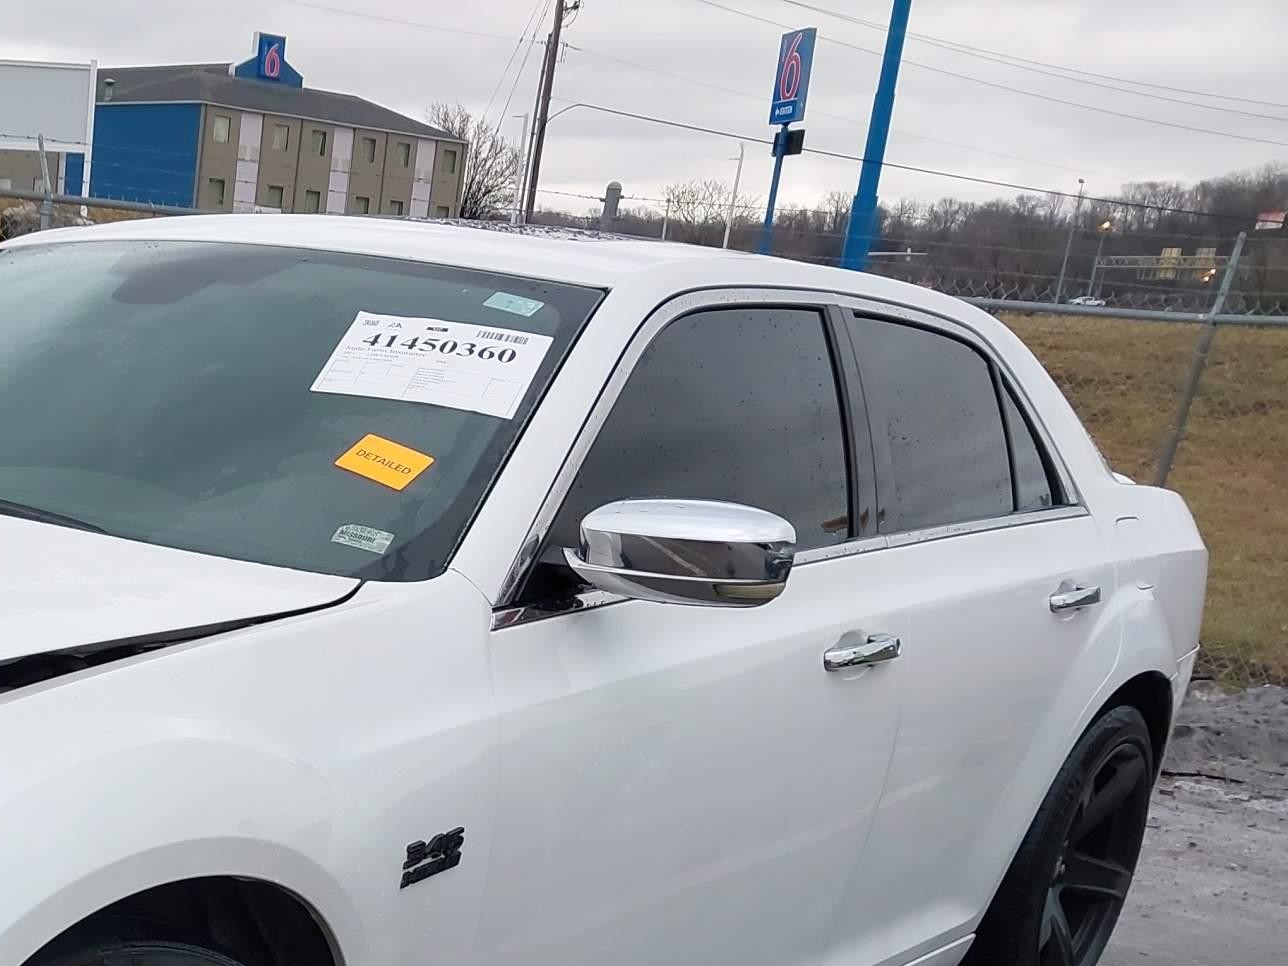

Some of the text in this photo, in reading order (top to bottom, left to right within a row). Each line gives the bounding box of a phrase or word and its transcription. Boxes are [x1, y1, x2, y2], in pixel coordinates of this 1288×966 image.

[264, 43, 280, 78] 6
[780, 32, 803, 101] 6
[362, 332, 518, 364] 41450360
[355, 448, 412, 476] DETAILED
